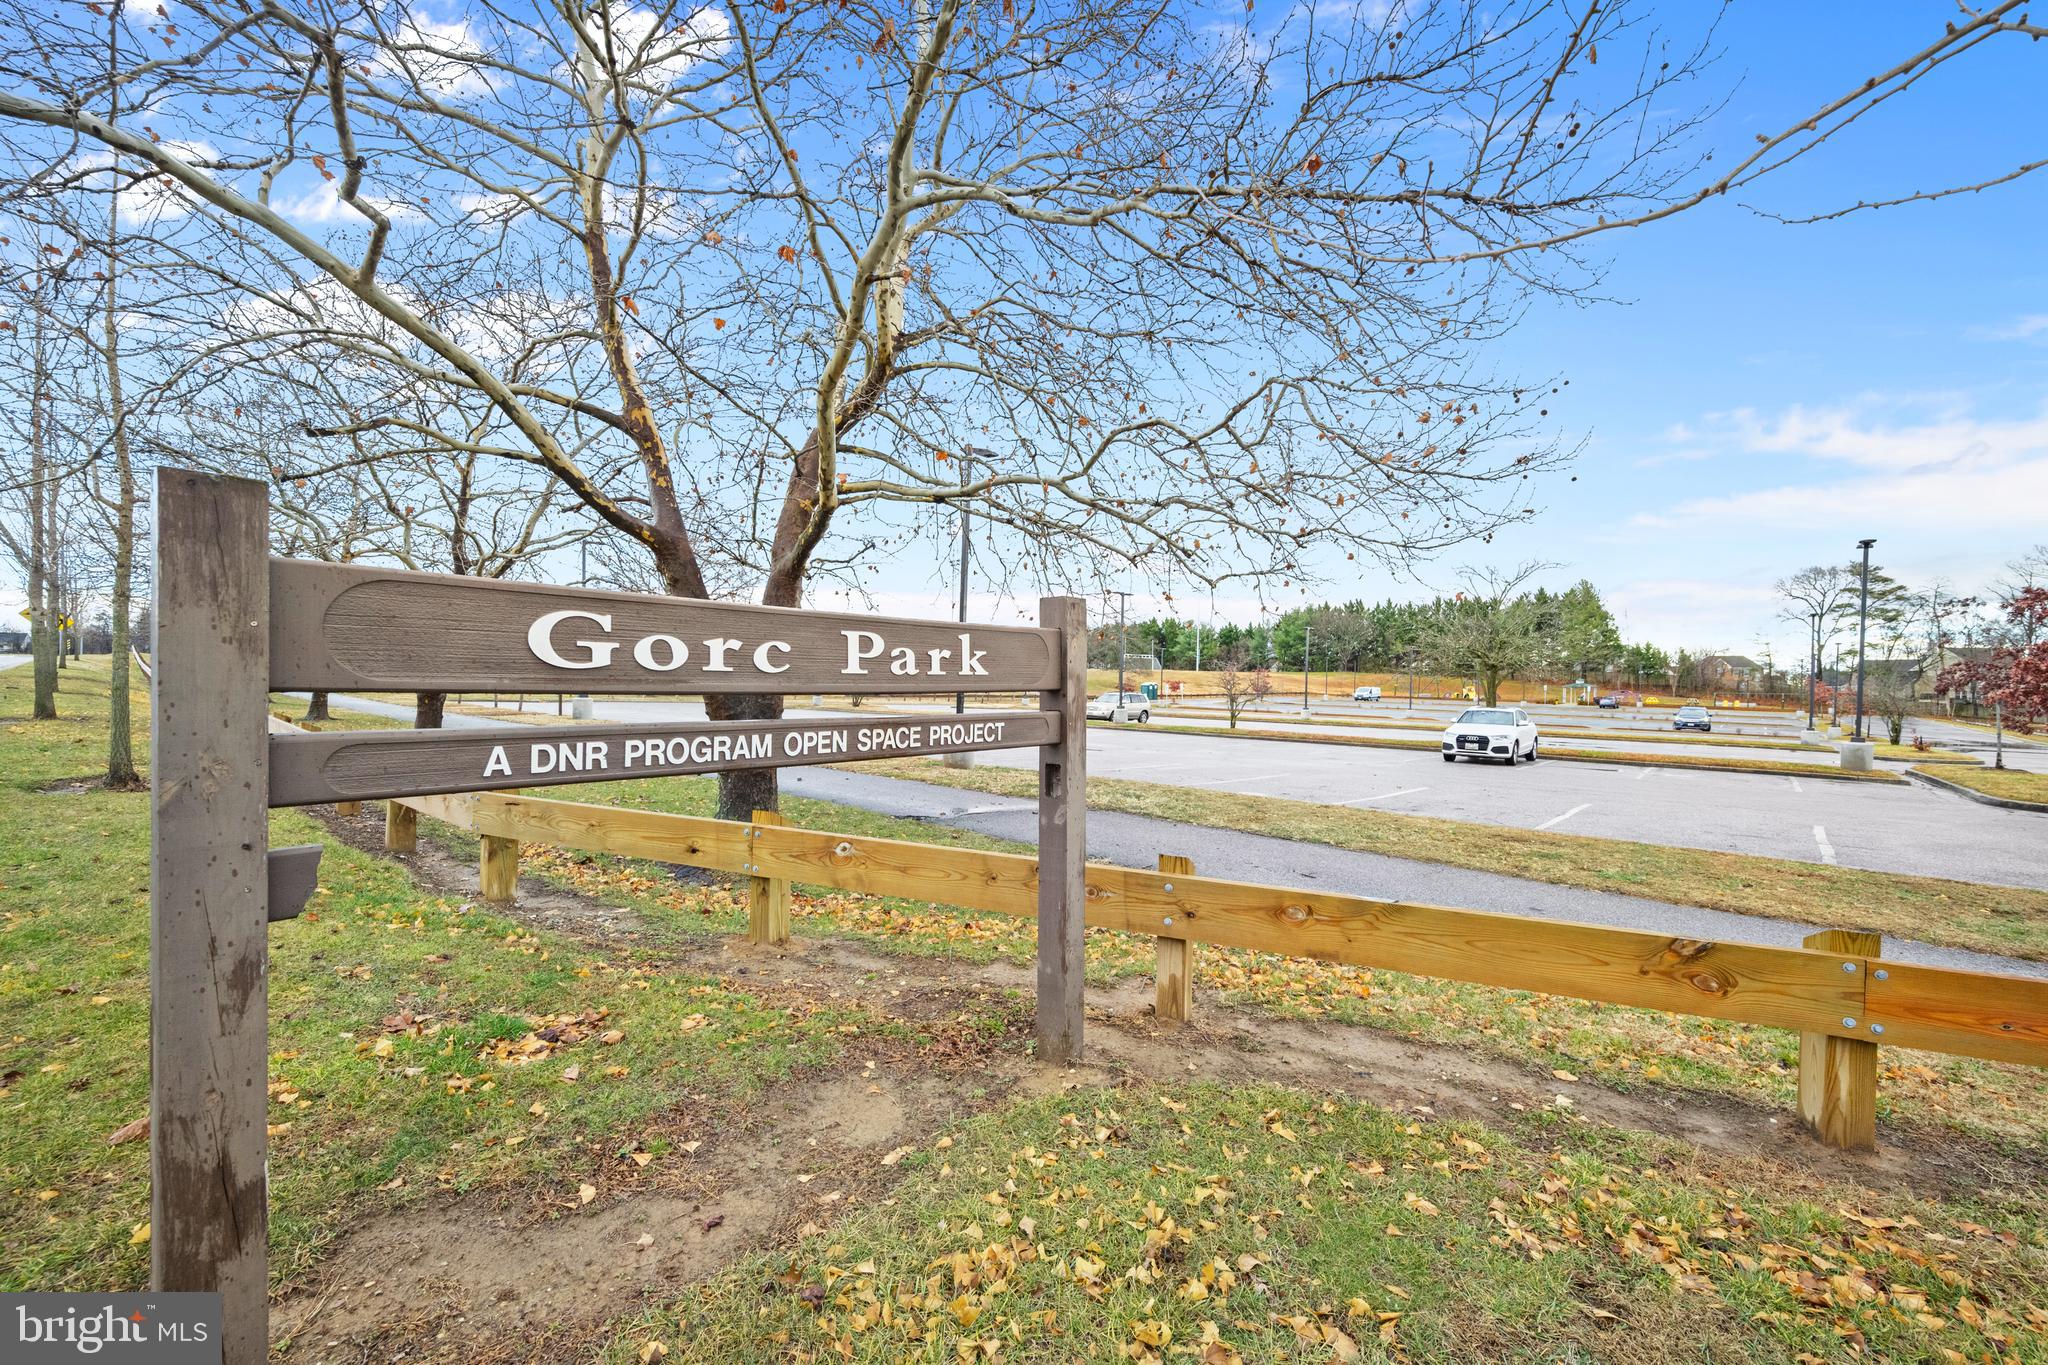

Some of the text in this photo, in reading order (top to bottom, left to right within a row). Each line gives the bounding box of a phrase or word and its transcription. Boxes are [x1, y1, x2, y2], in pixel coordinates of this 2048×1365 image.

[527, 610, 989, 676] Gorc Park
[482, 721, 1006, 777] A DNR PROGRAM OPEN SPACE PROJECT
